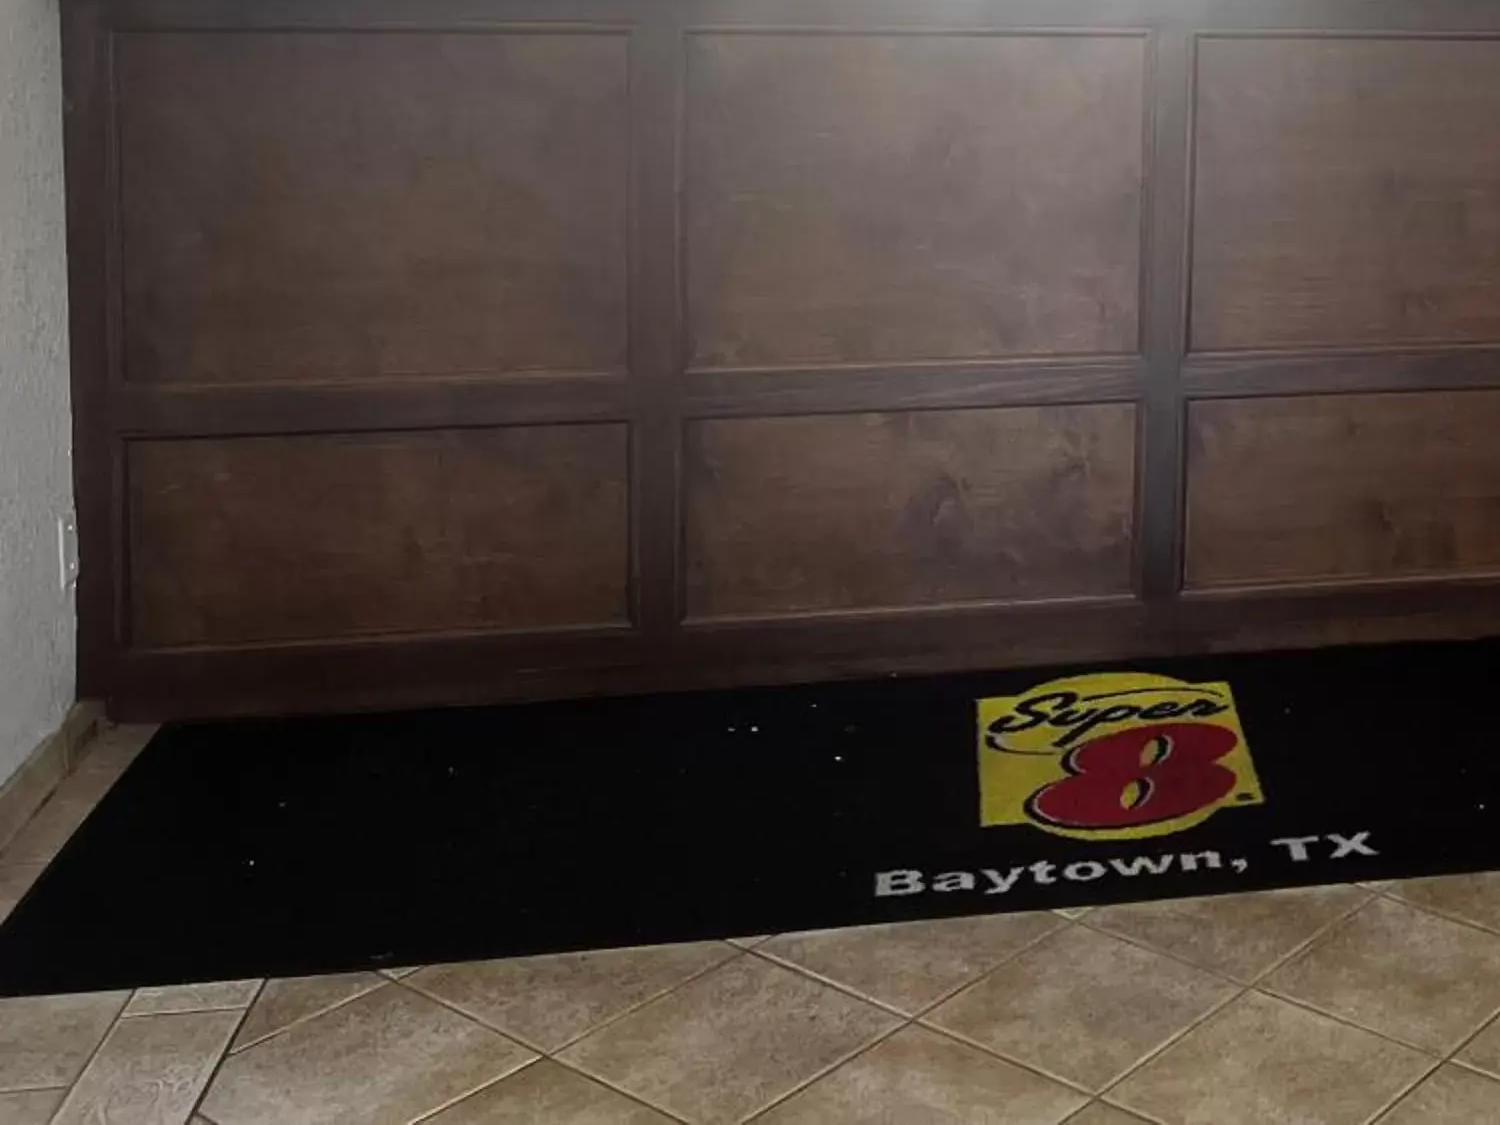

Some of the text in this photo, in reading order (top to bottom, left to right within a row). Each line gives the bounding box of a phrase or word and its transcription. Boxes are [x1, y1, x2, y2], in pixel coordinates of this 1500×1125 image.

[987, 691, 1230, 749] Super
[1023, 722, 1239, 831] 8
[874, 830, 1378, 897] Baytown, TX
